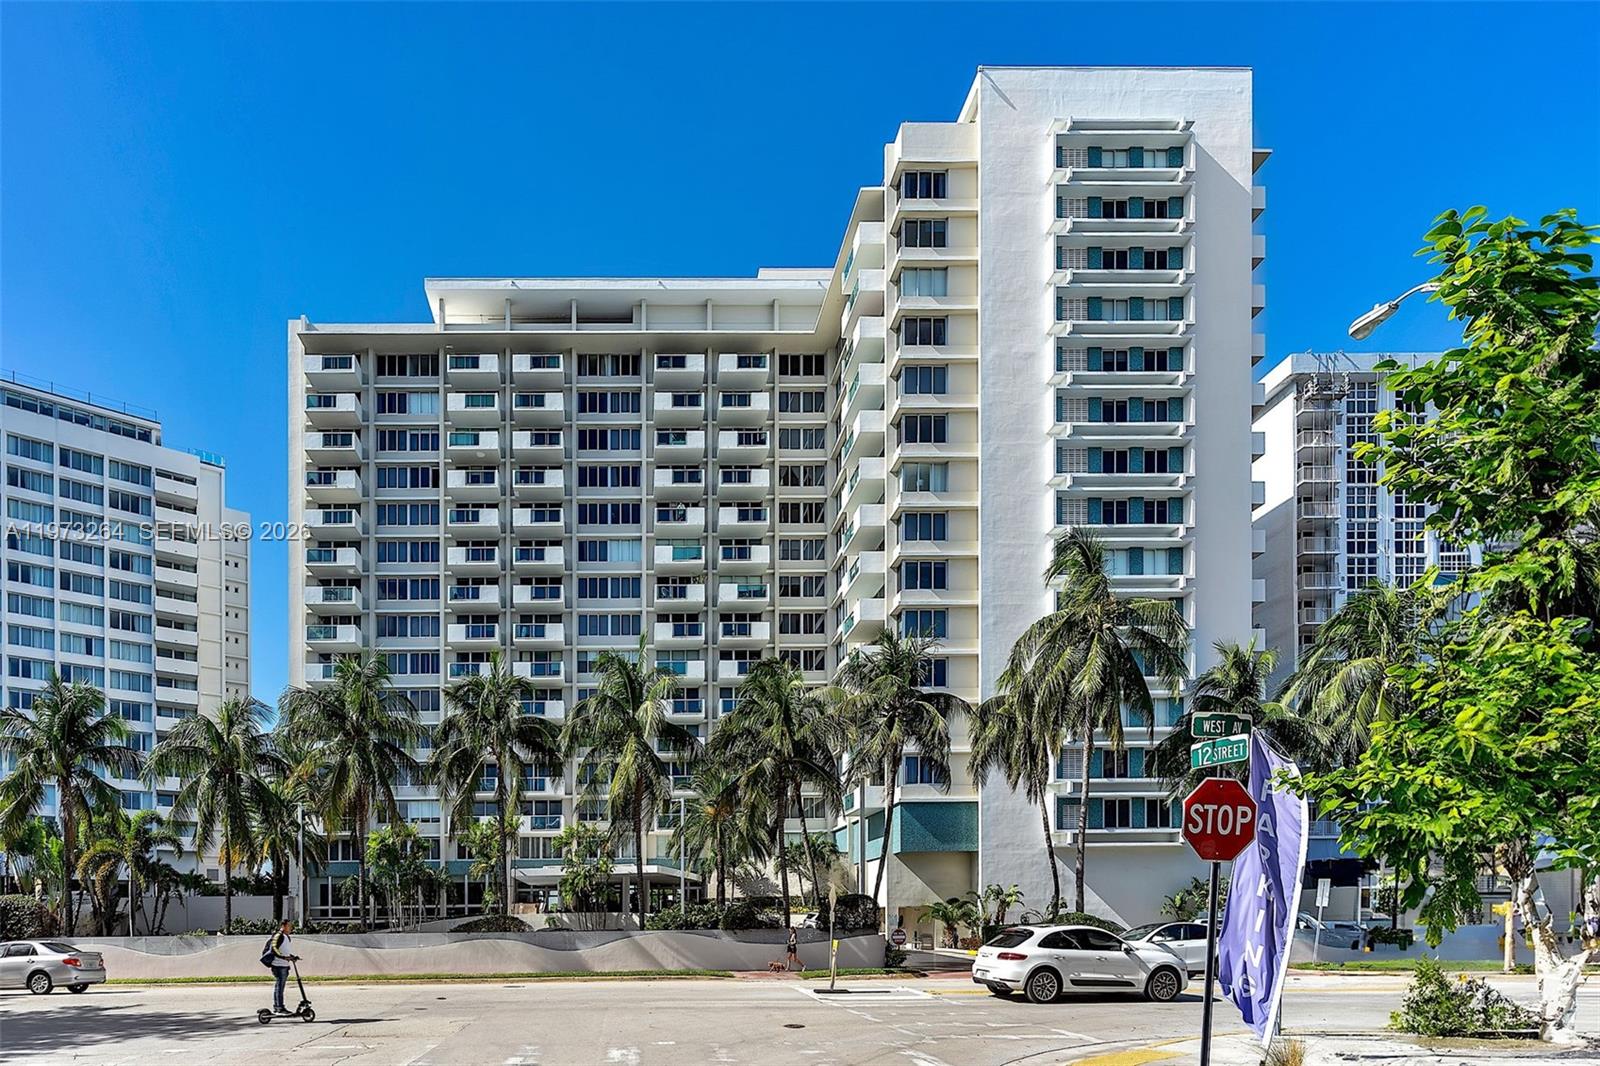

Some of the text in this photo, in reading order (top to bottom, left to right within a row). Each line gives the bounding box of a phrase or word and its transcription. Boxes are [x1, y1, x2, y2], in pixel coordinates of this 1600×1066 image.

[1203, 720, 1243, 734] WEST AV
[1198, 742, 1244, 766] 12 STREET
[1188, 804, 1252, 836] STOP
